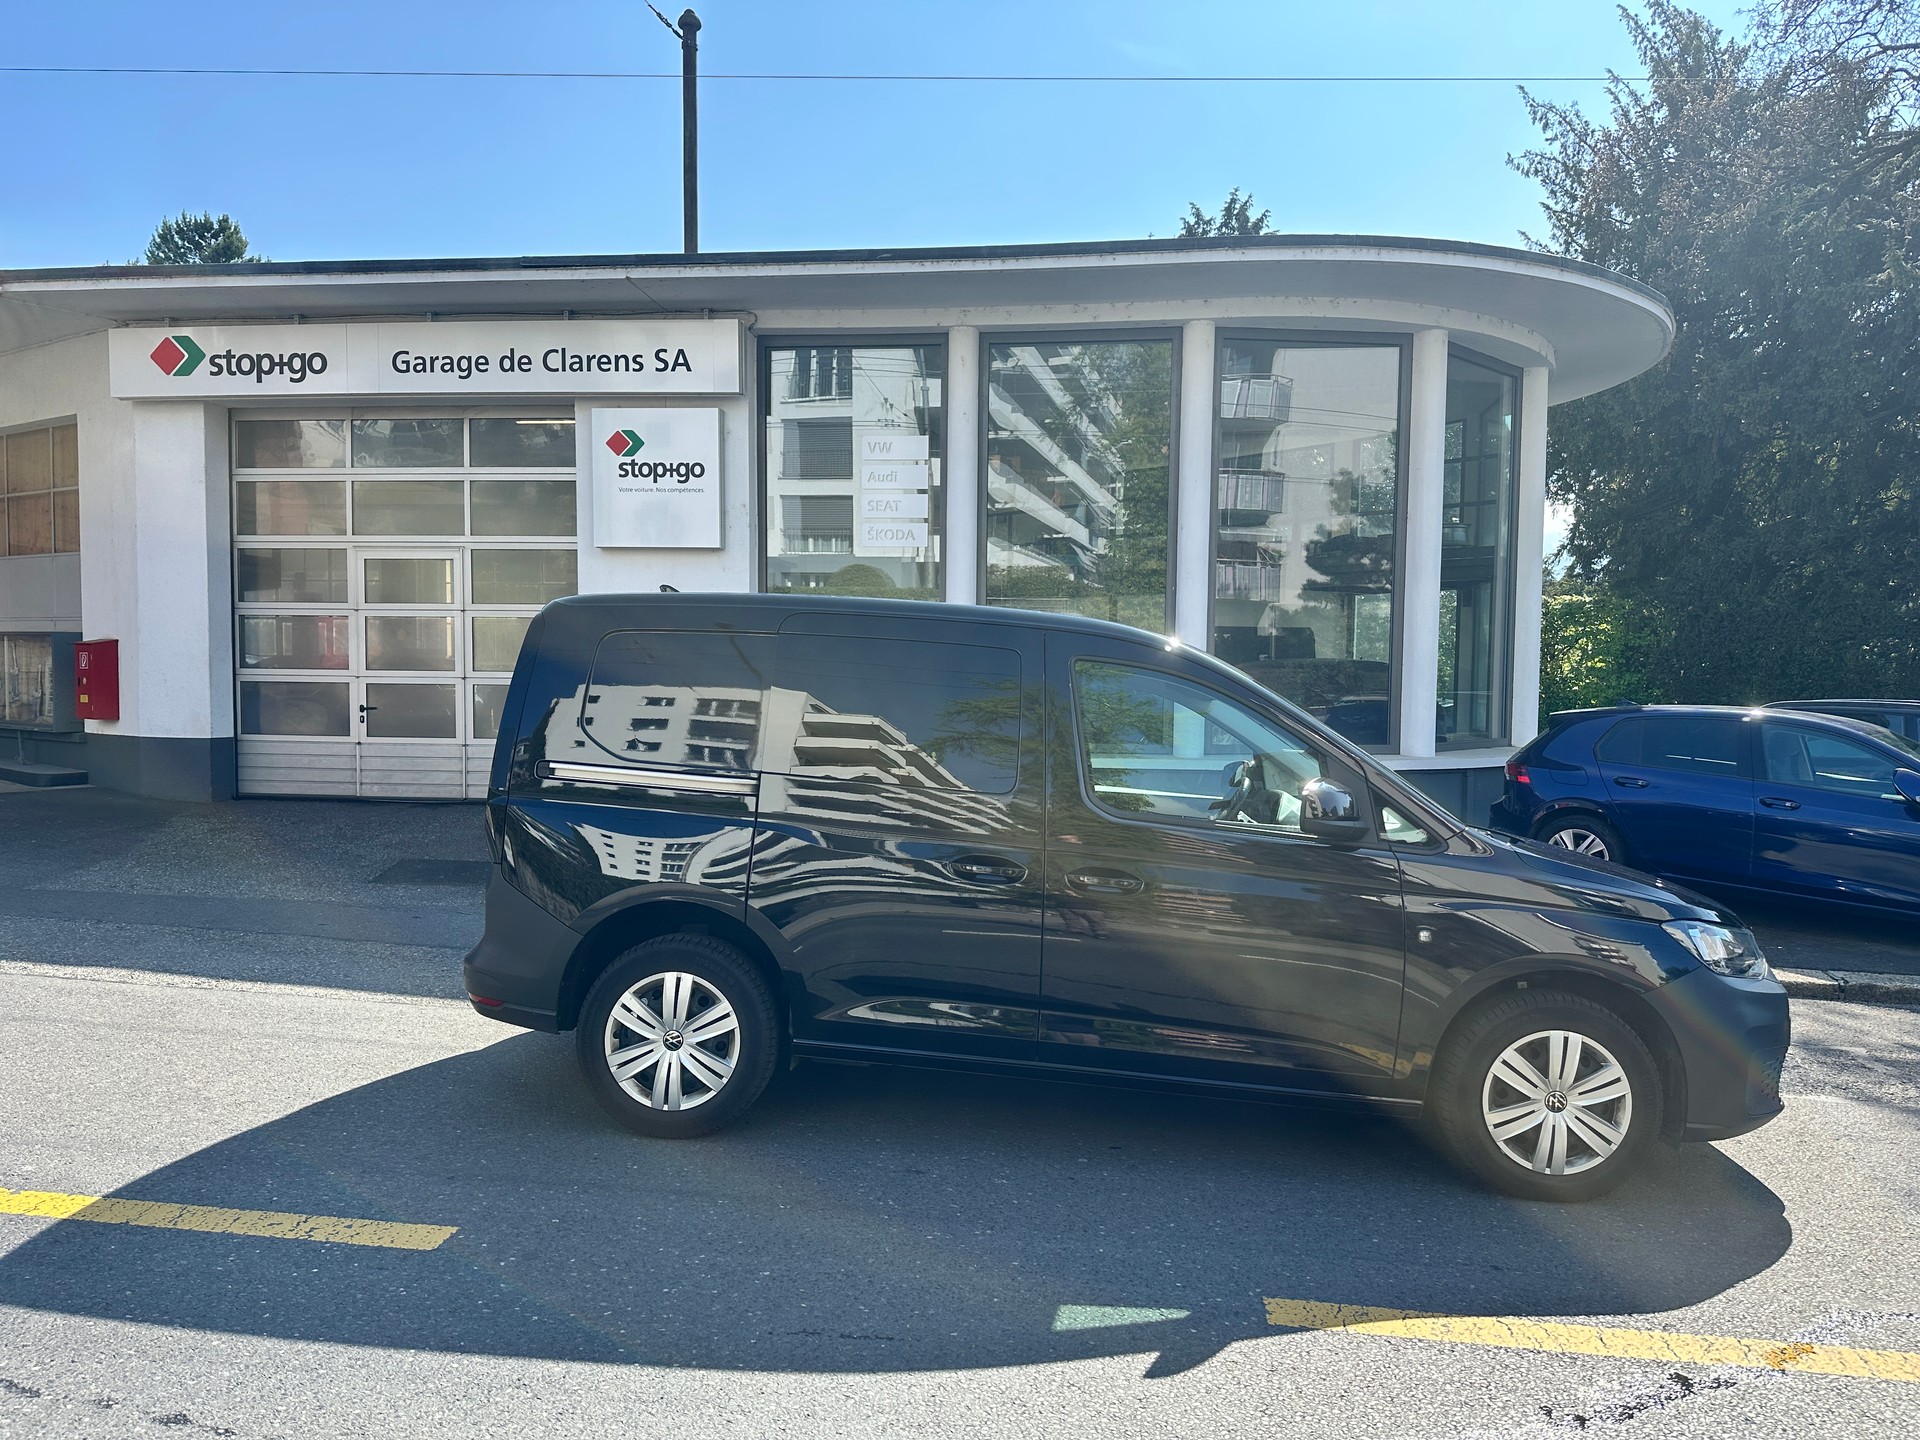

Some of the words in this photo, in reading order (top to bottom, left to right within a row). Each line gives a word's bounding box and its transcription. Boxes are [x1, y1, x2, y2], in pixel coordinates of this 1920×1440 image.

[209, 349, 328, 383] stop+go
[391, 350, 490, 380] Garage
[499, 348, 533, 373] de
[542, 348, 645, 373] Clarens
[654, 348, 692, 373] SA
[867, 442, 893, 454] VW
[618, 458, 706, 484] stop+go
[867, 471, 899, 483] Audi
[867, 500, 902, 512] SEAT
[867, 526, 916, 541] ŠKODA
